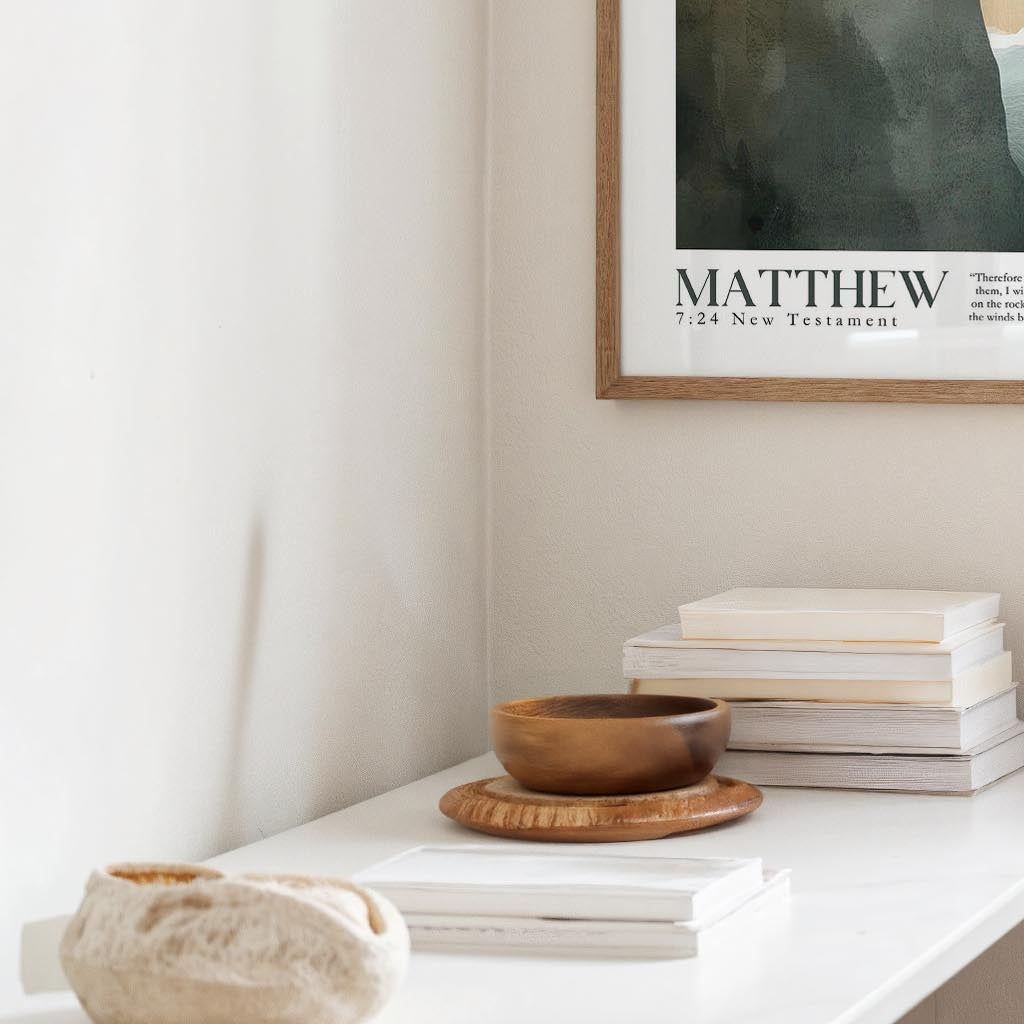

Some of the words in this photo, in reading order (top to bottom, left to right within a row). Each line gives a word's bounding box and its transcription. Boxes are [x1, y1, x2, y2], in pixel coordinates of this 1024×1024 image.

[676, 269, 949, 309] MATTHEW
[975, 285, 1003, 297] them,
[1005, 285, 1010, 296] I
[970, 300, 985, 309] on
[986, 298, 1003, 310] the
[676, 312, 720, 325] 7:24
[732, 312, 774, 326] New
[787, 313, 897, 327] Testament
[968, 311, 985, 322] the
[986, 311, 1016, 322] winds
